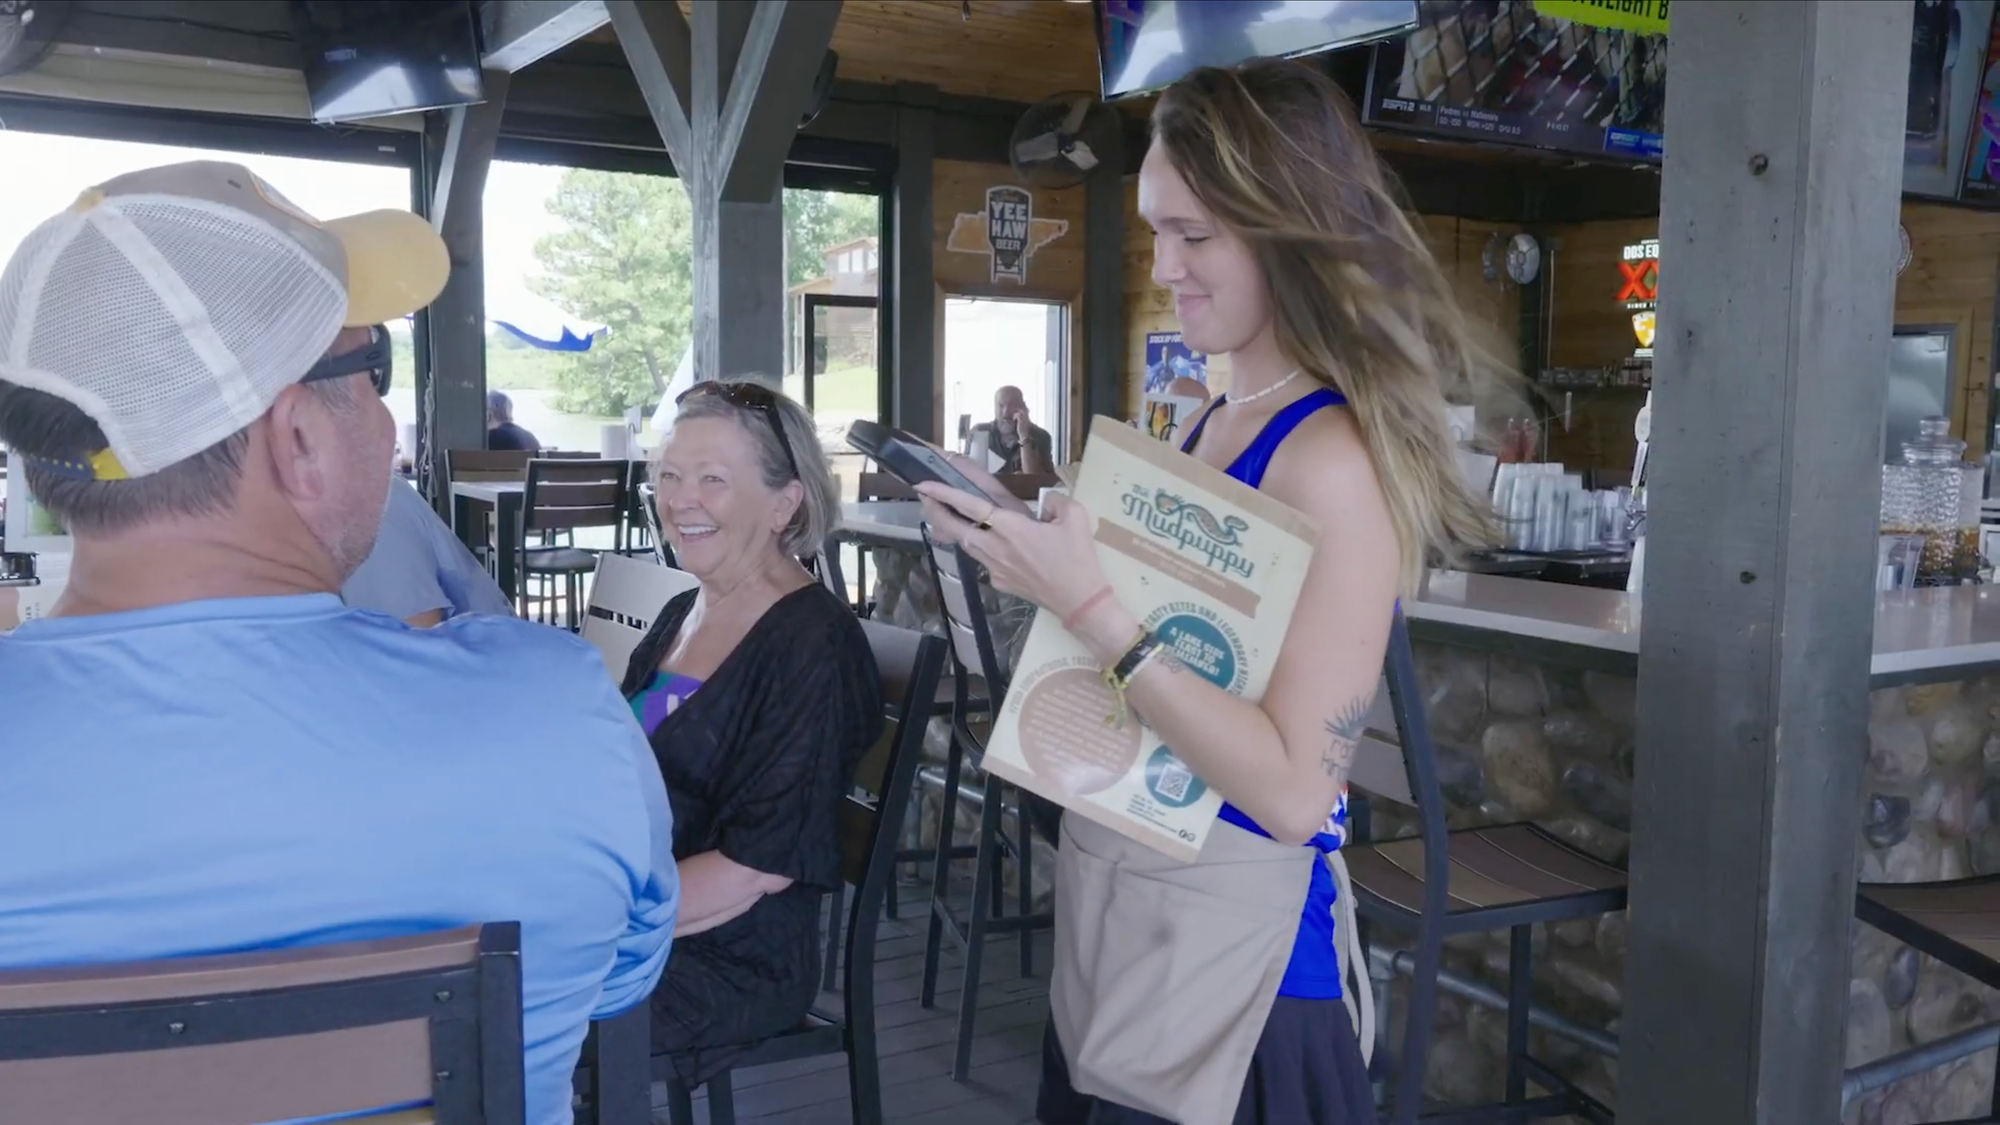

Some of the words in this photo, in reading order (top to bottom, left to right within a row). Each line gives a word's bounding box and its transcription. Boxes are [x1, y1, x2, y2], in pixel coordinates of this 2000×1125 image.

[1440, 105, 1461, 117] Padres
[1470, 110, 1499, 122] Nationals
[991, 201, 1027, 221] YEE
[992, 219, 1027, 239] HAW
[996, 238, 1021, 251] BEER
[1623, 244, 1644, 260] DOS
[1122, 492, 1255, 579] Mudpuppy
[1144, 604, 1169, 627] TASTY
[1168, 601, 1197, 614] BITES
[1198, 606, 1217, 622] AND
[1217, 618, 1249, 668] LEGENDARY
[1169, 626, 1178, 637] A
[1179, 630, 1203, 648] LAKE
[1203, 642, 1226, 660] SIDE
[1172, 648, 1221, 677] MEMBER!
[1174, 638, 1203, 659] FEAST
[1203, 652, 1217, 665] TO
